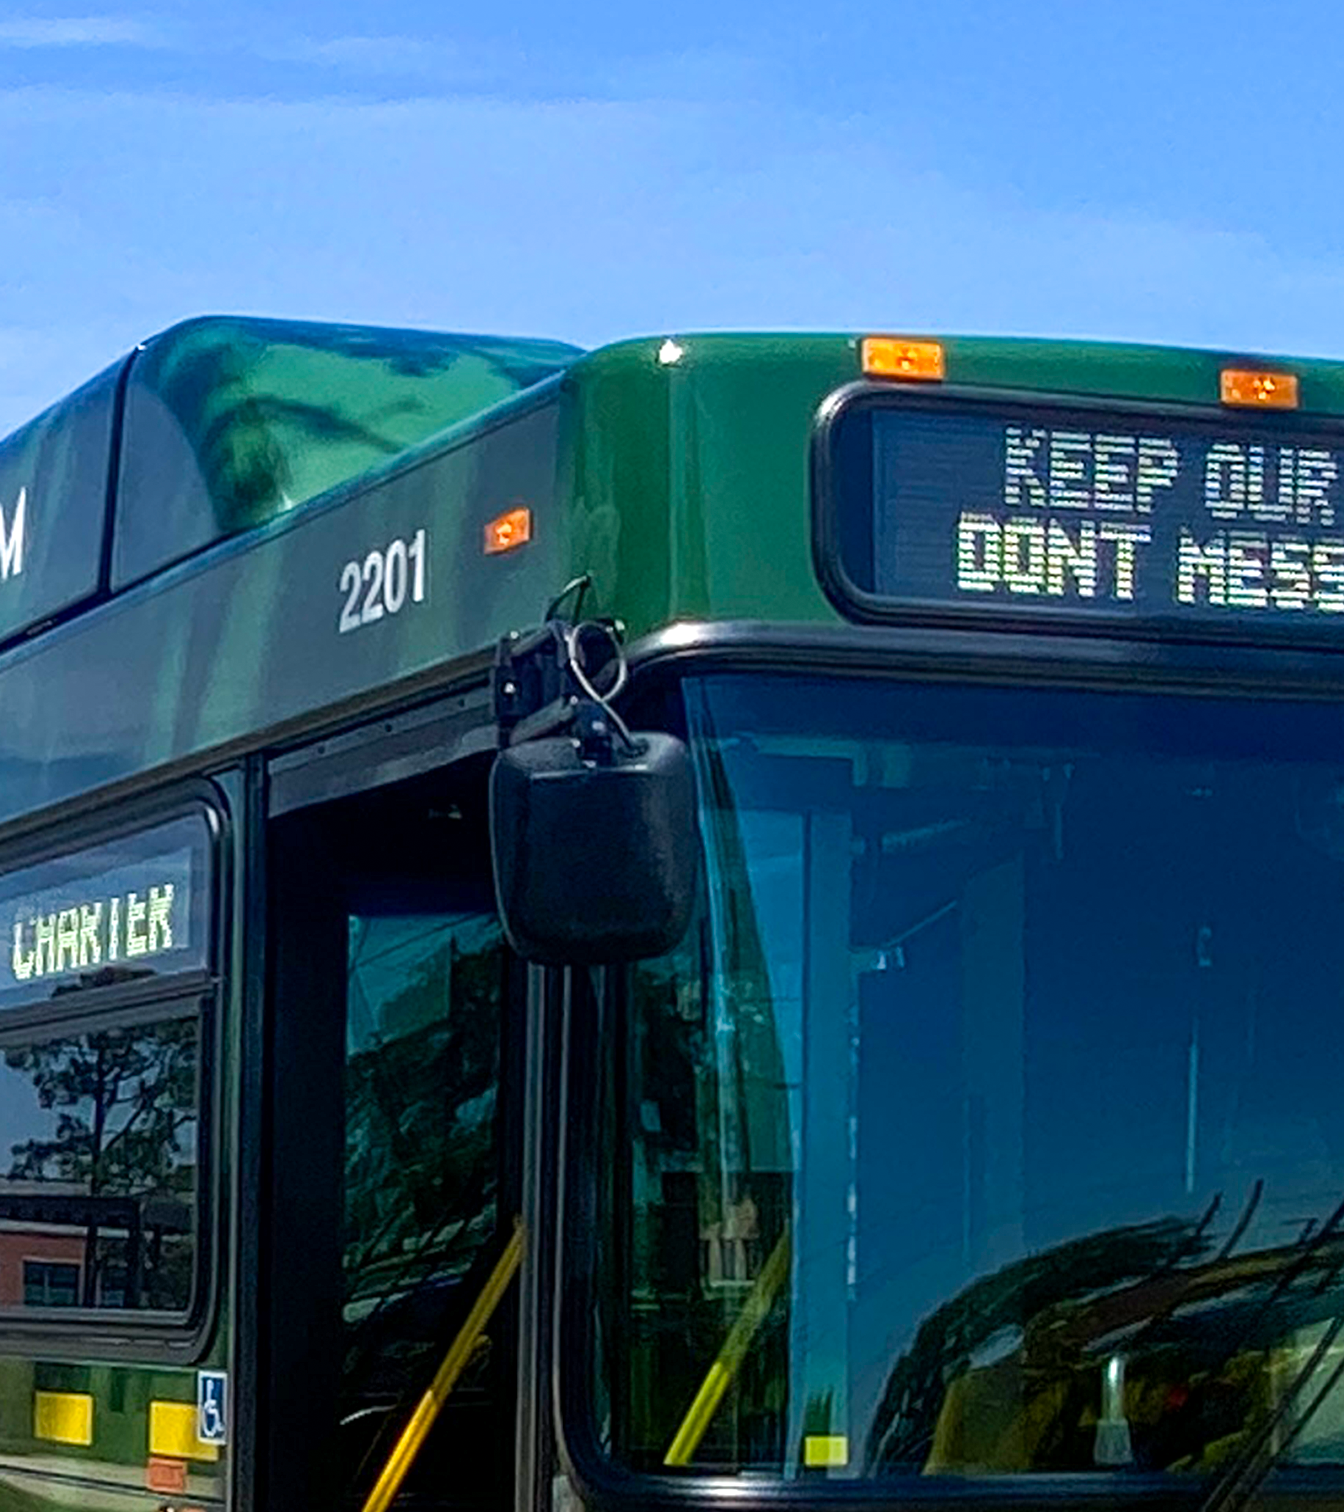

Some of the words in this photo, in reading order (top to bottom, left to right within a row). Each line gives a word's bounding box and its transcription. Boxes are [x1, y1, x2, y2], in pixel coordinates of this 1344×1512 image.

[1004, 426, 1180, 513] KEEP
[1204, 443, 1338, 527] OUR
[338, 528, 426, 634] 2201
[957, 511, 1152, 600] DONT
